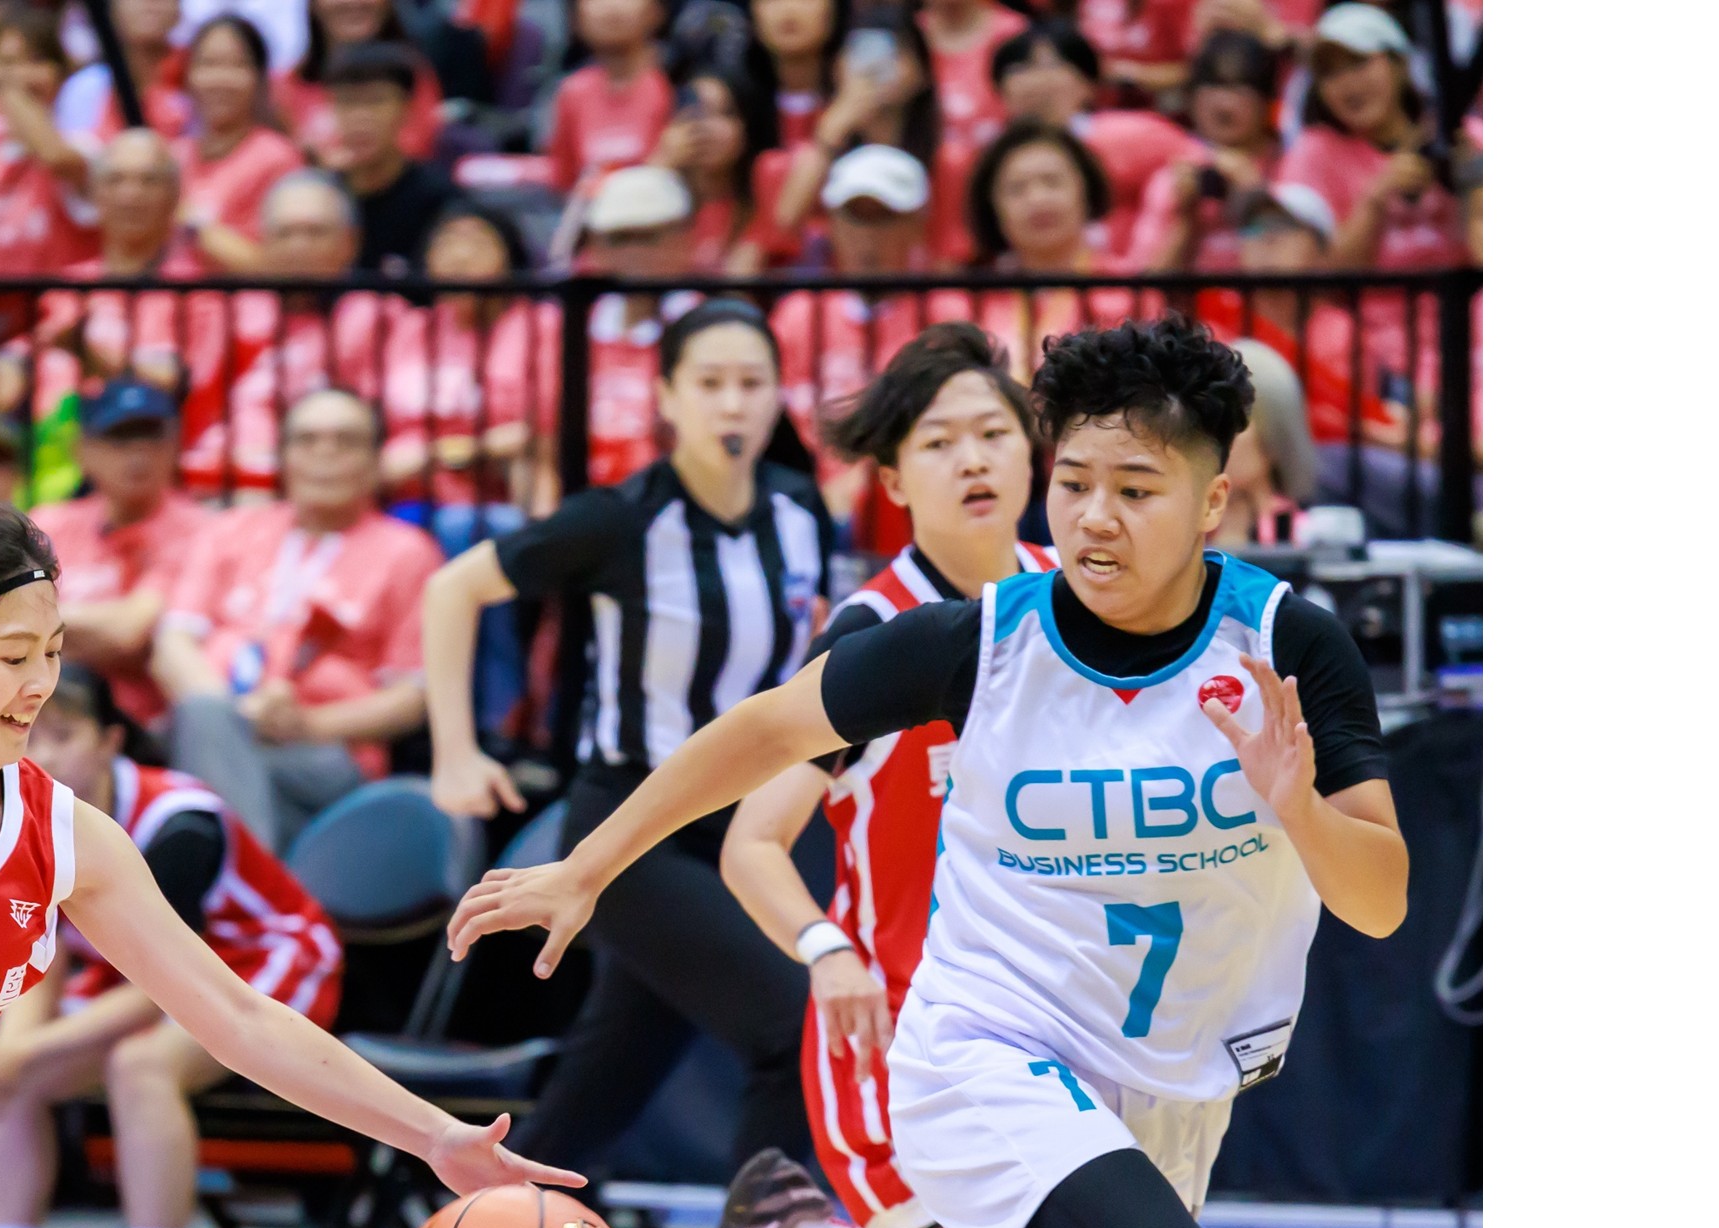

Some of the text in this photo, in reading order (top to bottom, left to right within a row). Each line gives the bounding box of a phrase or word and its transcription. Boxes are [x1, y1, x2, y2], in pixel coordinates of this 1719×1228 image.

[1005, 757, 1257, 841] CTBC
[997, 833, 1269, 877] BUSINESS SCHOOL
[1103, 901, 1184, 1039] 7
[1028, 1059, 1097, 1113] 7
